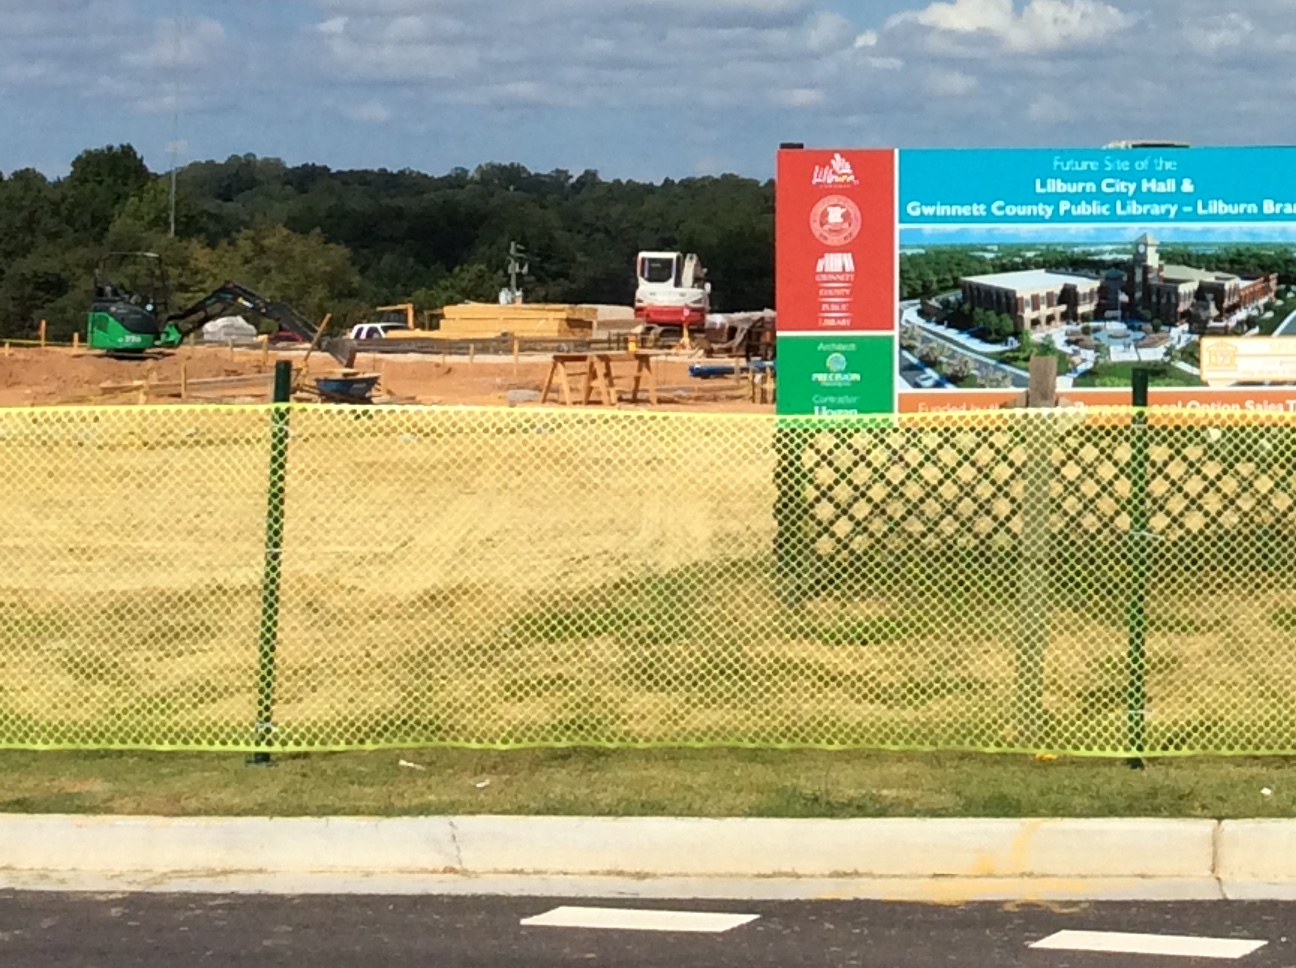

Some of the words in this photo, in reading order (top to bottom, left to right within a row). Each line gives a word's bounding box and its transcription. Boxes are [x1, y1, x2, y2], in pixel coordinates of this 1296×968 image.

[1053, 155, 1099, 171] Future
[1104, 155, 1130, 171] Site
[1135, 155, 1150, 171] of
[1154, 155, 1178, 171] the
[1035, 178, 1096, 193] Lilburn
[1101, 178, 1136, 196] City
[1141, 178, 1176, 193] Hall
[1181, 178, 1194, 193] &
[906, 200, 987, 216] Gwinnett
[990, 200, 1054, 219] County
[1059, 200, 1111, 216] Public
[1115, 200, 1178, 218] Library
[1197, 199, 1258, 215] Lilburn
[1245, 400, 1284, 412] Sales
